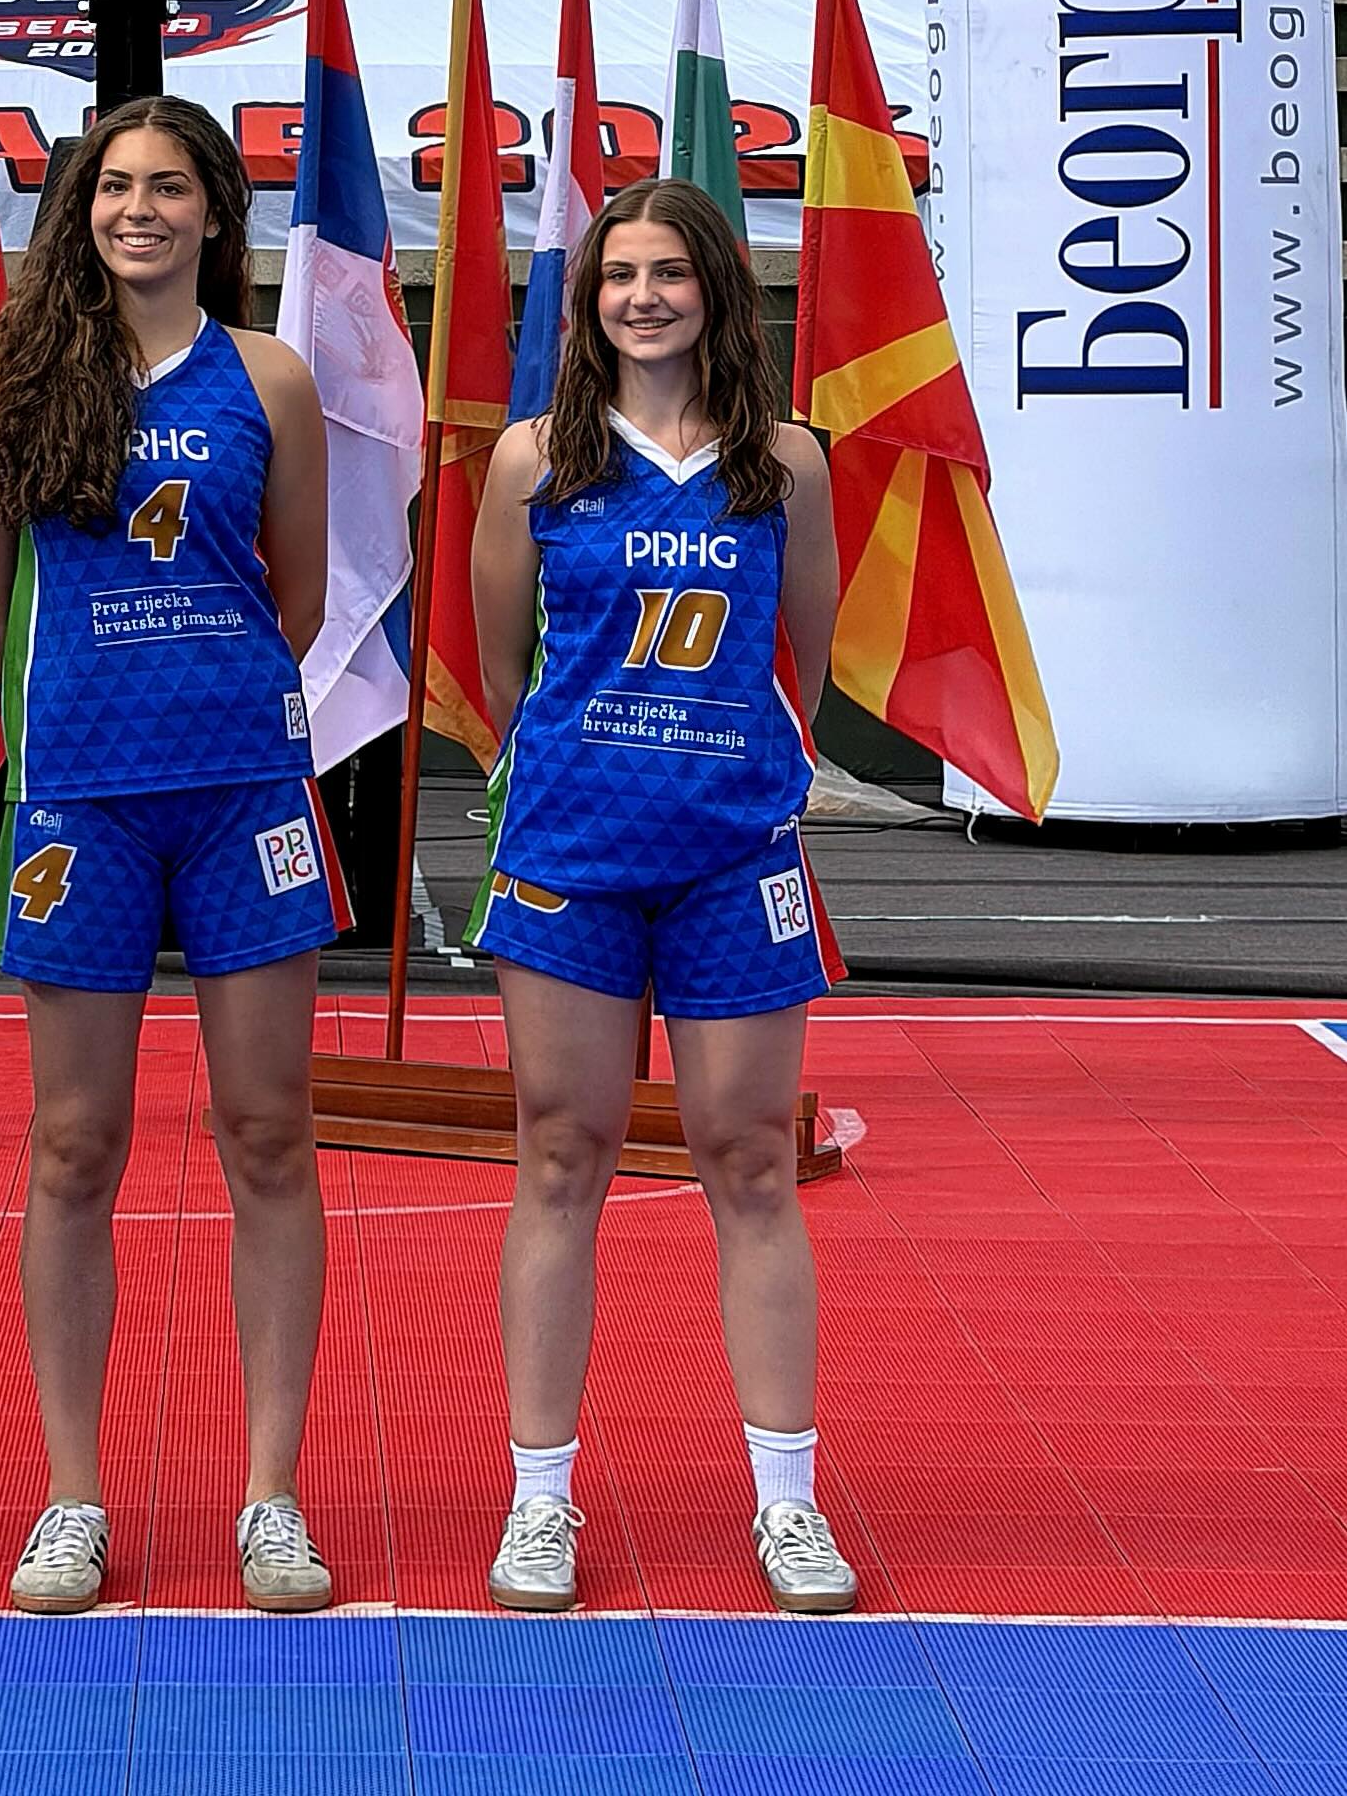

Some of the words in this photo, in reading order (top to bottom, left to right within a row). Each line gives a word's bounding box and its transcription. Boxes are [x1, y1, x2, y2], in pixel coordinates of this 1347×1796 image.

[28, 42, 96, 58] 20
[126, 428, 209, 461] RHG
[128, 480, 190, 561] 4
[625, 531, 737, 569] PRHG
[91, 600, 130, 617] Prva
[135, 593, 192, 615] riječka
[93, 613, 167, 635] hrvatska
[621, 588, 731, 672] 10
[586, 698, 624, 715] Prva
[629, 701, 687, 723] riječka
[582, 714, 657, 737] hrvatska
[662, 724, 746, 750] gimnazija
[264, 827, 306, 862] PR
[10, 843, 78, 924] 4
[271, 851, 312, 887] HG
[768, 877, 801, 910] PR
[774, 902, 806, 935] HG
